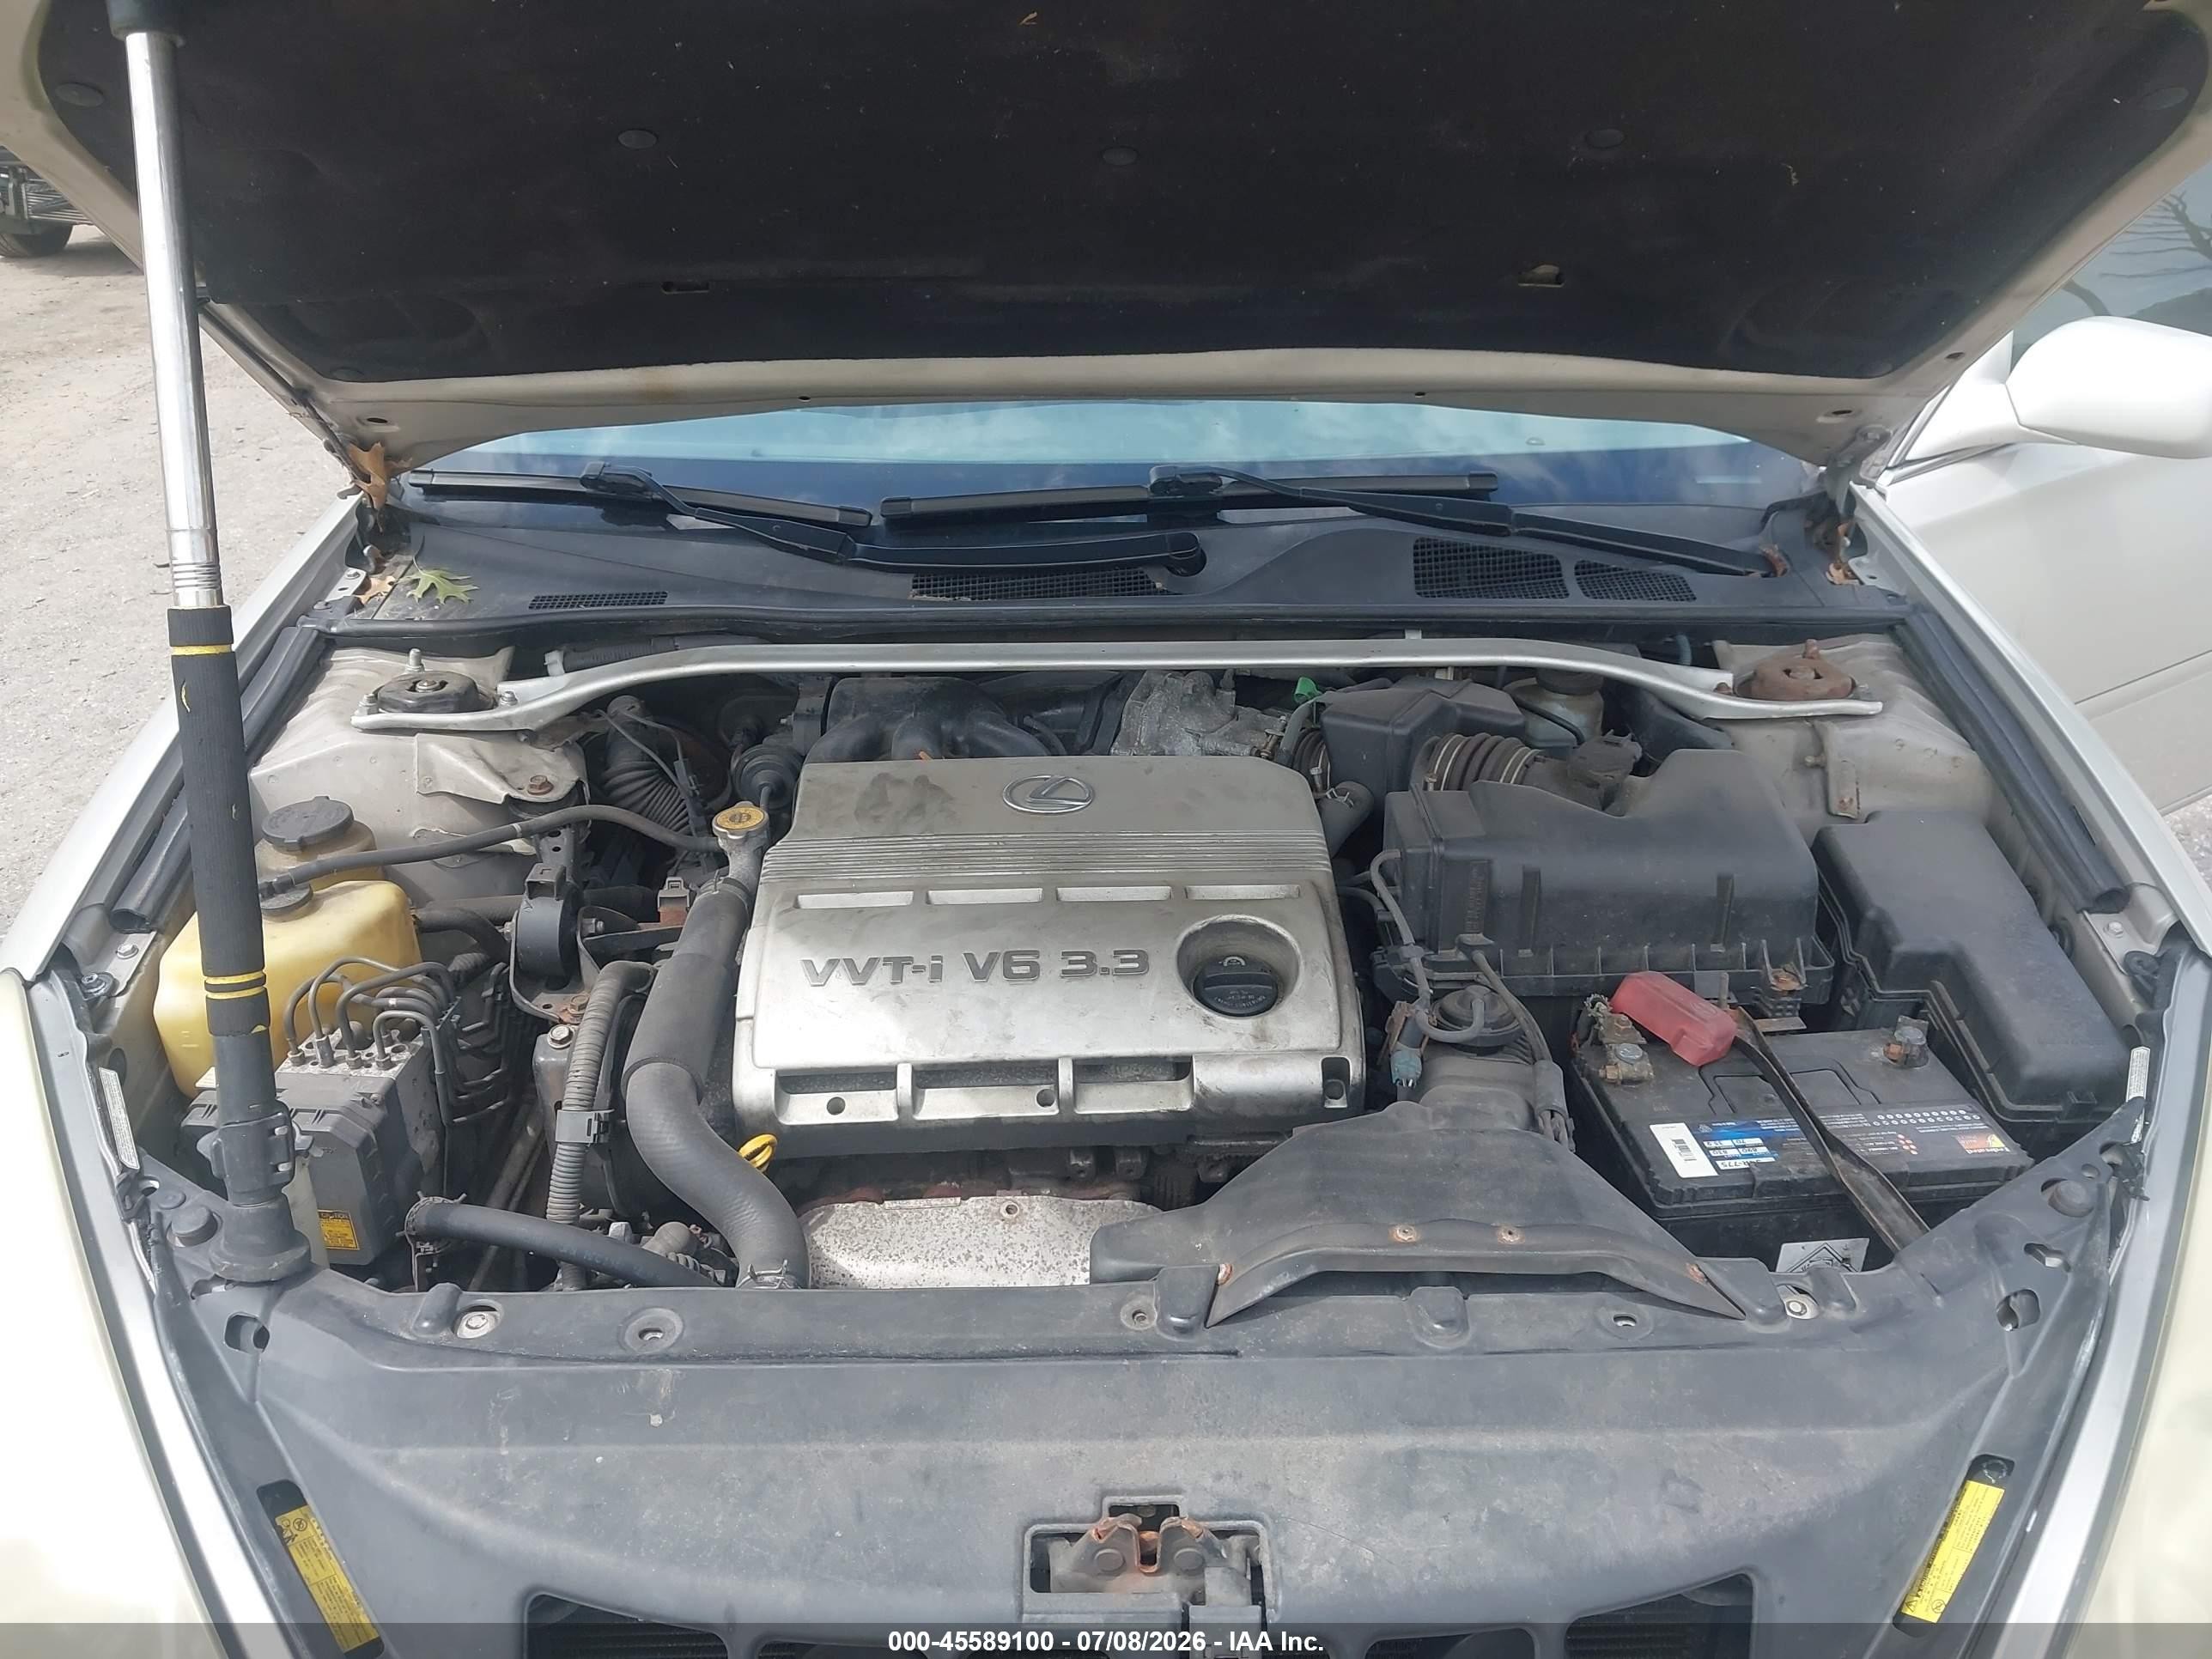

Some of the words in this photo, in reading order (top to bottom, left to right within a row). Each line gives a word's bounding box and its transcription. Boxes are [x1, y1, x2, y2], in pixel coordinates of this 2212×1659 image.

[801, 955, 944, 987] VVT-i
[962, 949, 1042, 983] V6
[1060, 949, 1151, 978] 3.3
